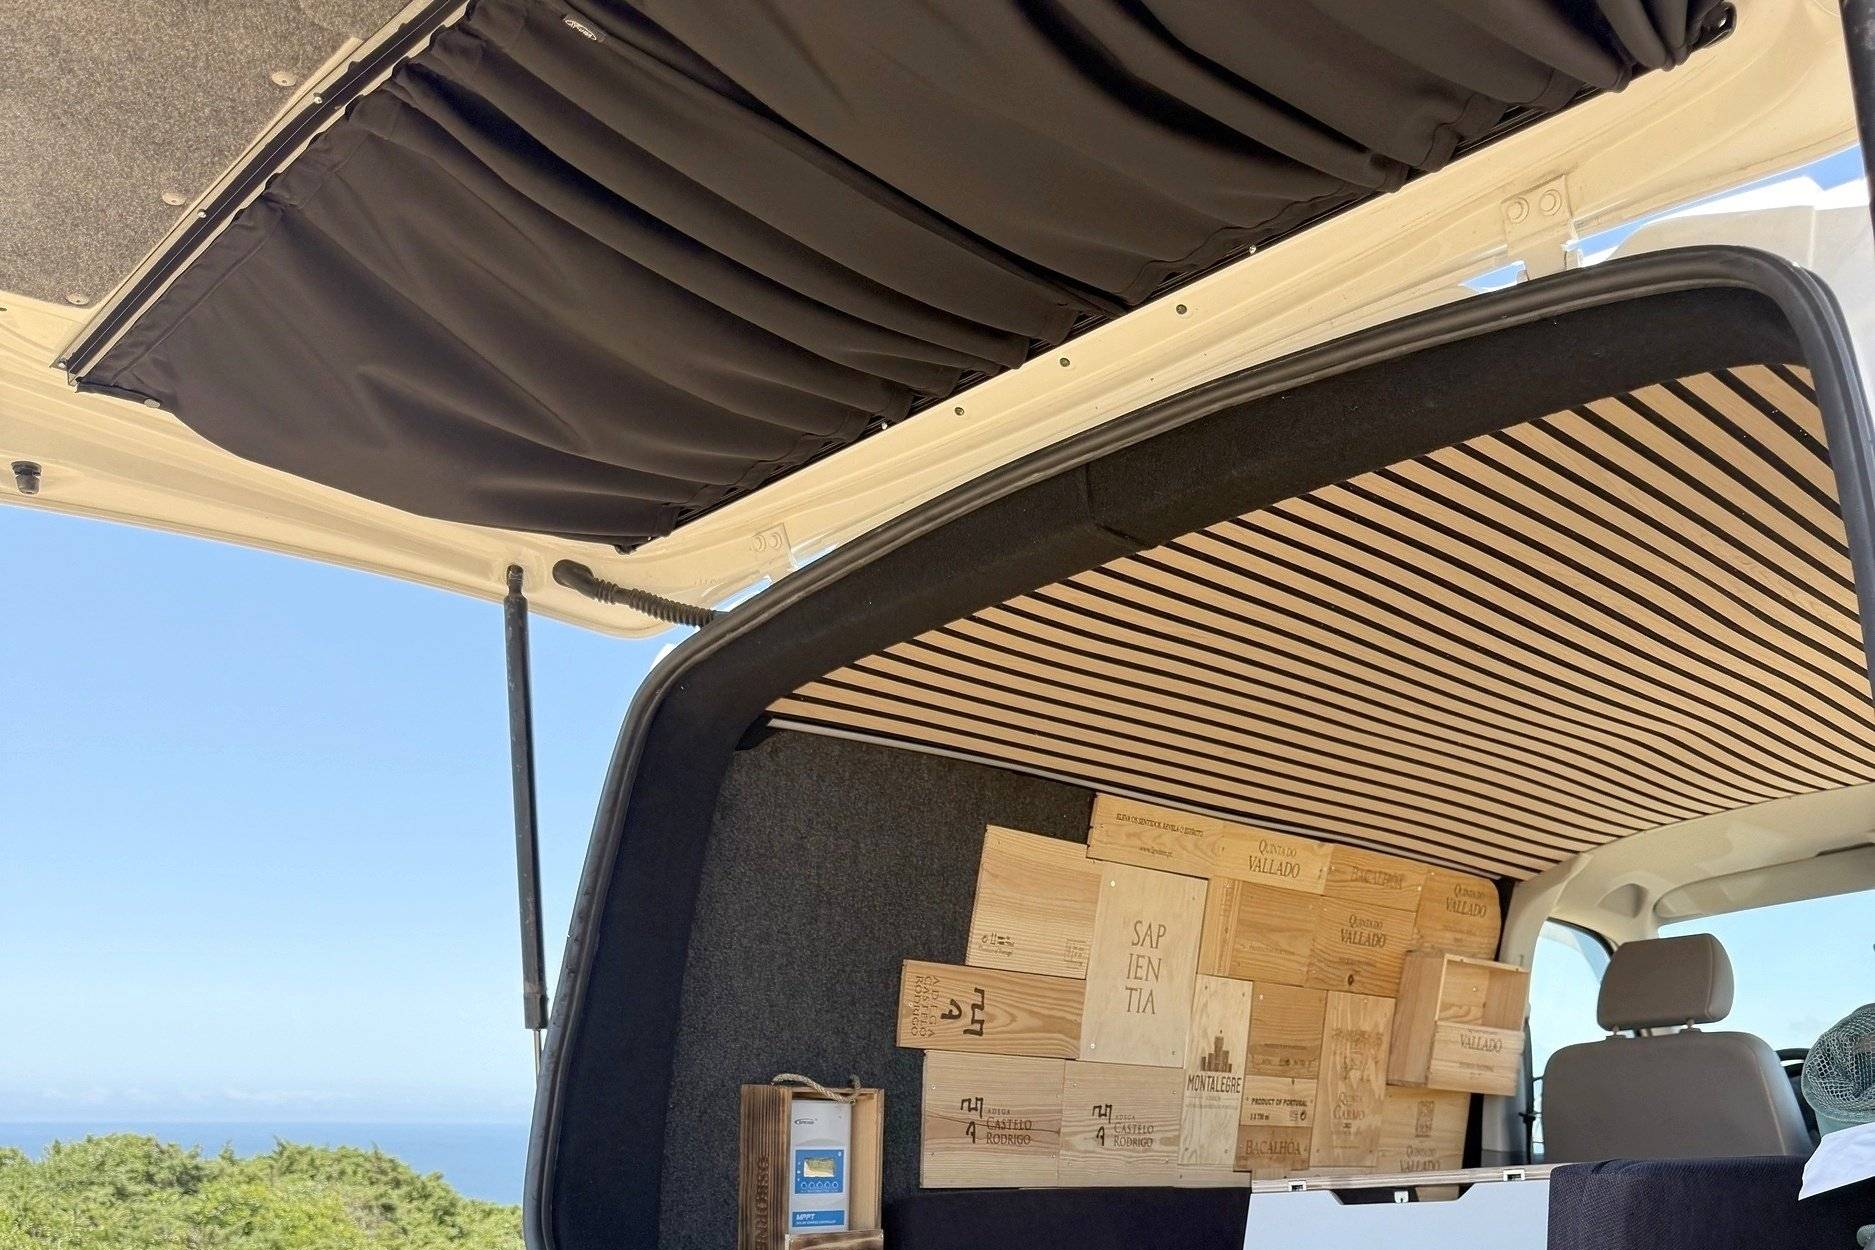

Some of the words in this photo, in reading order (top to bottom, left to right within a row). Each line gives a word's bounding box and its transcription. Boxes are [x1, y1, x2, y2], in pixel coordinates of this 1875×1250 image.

[1249, 855, 1300, 879] VALLADO
[1446, 897, 1487, 918] VALLADO
[1131, 919, 1167, 949] SAP
[1340, 928, 1386, 948] VALLADO
[1126, 952, 1162, 983] IEN
[1124, 985, 1156, 1015] TIA
[1460, 1033, 1504, 1053] VALLADO
[1187, 1074, 1242, 1094] MONTALEGRE
[986, 1116, 1033, 1131] CASTELO
[1113, 1123, 1154, 1135] CASTELO
[986, 1131, 1032, 1146] RODRIGO
[1113, 1135, 1154, 1148] RODRIGO
